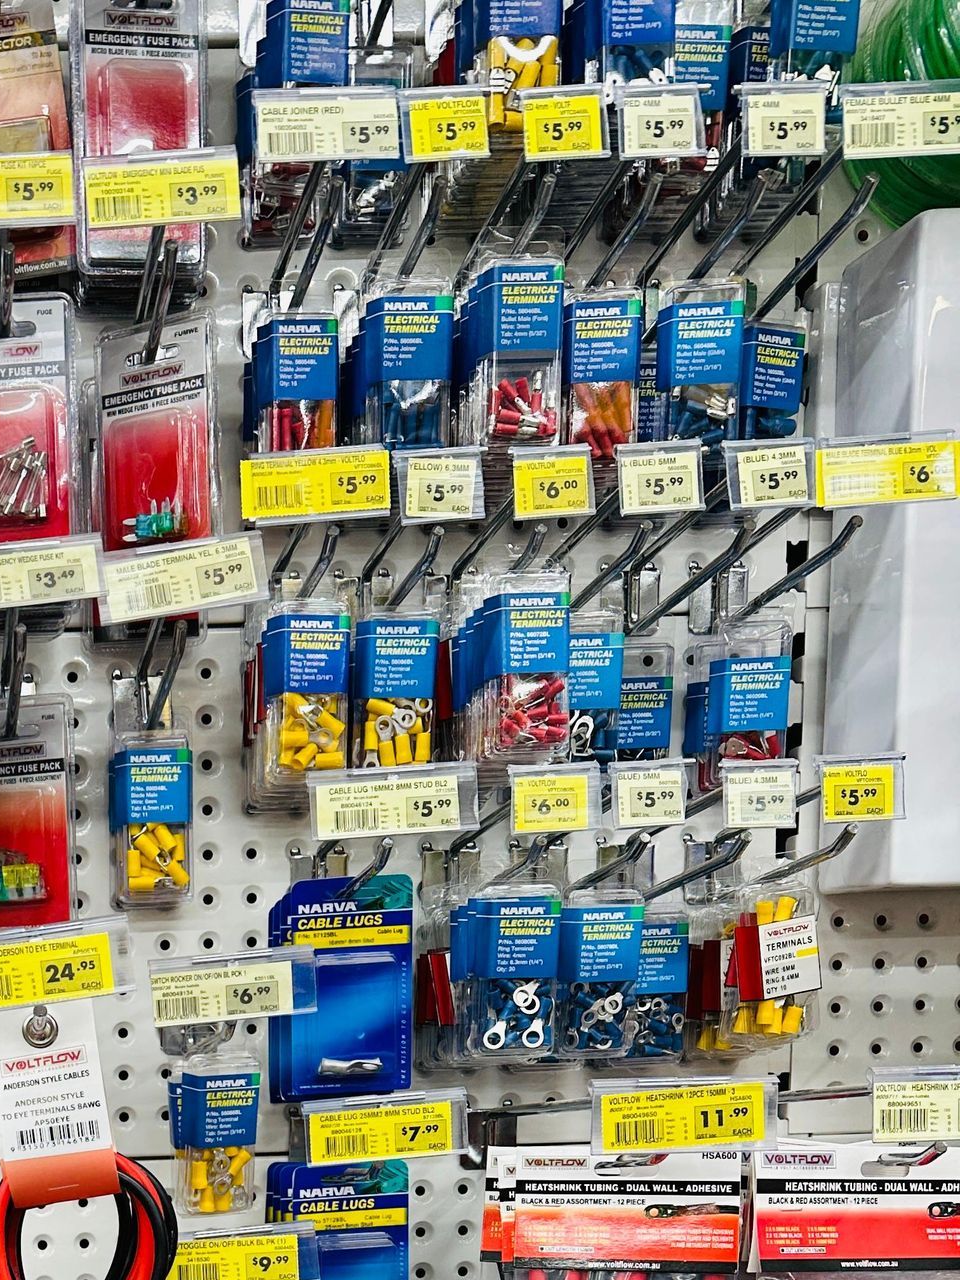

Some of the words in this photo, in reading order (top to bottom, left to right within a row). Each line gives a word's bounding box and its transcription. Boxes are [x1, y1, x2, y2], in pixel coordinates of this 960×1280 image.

[109, 14, 176, 26] VOLTFLOW
[89, 33, 144, 45] EMERGENCY
[146, 36, 170, 46] FUSE
[172, 36, 195, 48] PACK
[436, 99, 479, 109] VOLTFLOW
[845, 98, 876, 107] FEMALE
[878, 97, 908, 105] BULLET
[910, 96, 930, 104] BLUE
[932, 94, 951, 103] 4MM
[262, 107, 288, 115] CABLE
[290, 107, 320, 115] JOINER
[321, 106, 344, 116] (RED)
[502, 272, 547, 281] NARVA
[502, 286, 559, 295] ELECTRICAL
[502, 294, 555, 304] TERMINALS
[743, 454, 769, 464] (BLUE)
[772, 451, 796, 461] 4.3MM
[731, 662, 774, 670] NARVA
[730, 673, 784, 683] ELECTRICAL
[730, 680, 780, 691] TERMINALS
[298, 902, 357, 914] NARVA
[298, 916, 342, 930] CABLE
[346, 915, 383, 926] LUGS
[766, 923, 809, 937] VOLTFLOW
[48, 941, 78, 951] TERMINAL
[766, 936, 813, 951] TERMINALS
[5, 1051, 82, 1071] VOLTFLOW
[2, 1112, 12, 1120] TO
[14, 1111, 28, 1119] EYE
[31, 1105, 74, 1117] TERMINALS
[77, 1101, 101, 1111] 8AWG
[319, 1114, 340, 1122] CABLE
[384, 1110, 399, 1118] 8MM
[402, 1108, 420, 1116] STUD
[702, 1152, 737, 1160] HSA600
[525, 1183, 581, 1192] HEATSHRINK
[584, 1183, 619, 1192] TUBING
[625, 1184, 649, 1192] DUAL
[652, 1184, 676, 1192] WALL
[686, 1184, 732, 1192] ADHESIVE
[588, 1261, 661, 1269] www.voltflow.com.au
